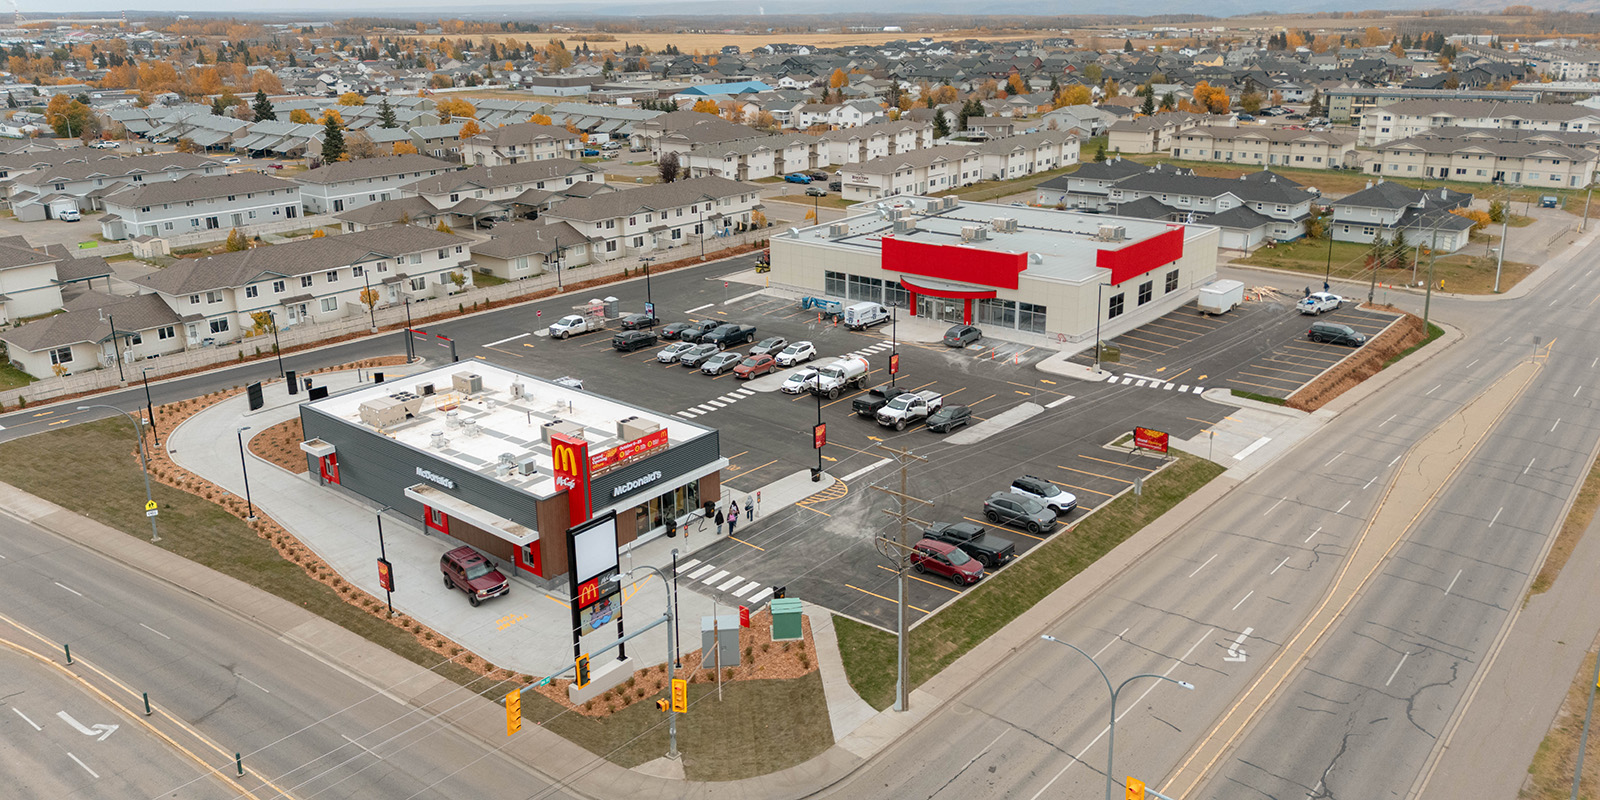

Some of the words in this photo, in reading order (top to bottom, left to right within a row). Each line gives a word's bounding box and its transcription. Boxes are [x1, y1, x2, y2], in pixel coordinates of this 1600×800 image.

[416, 466, 453, 489] McDonald's
[614, 471, 662, 497] McDonald's
[496, 614, 516, 625] YOU
